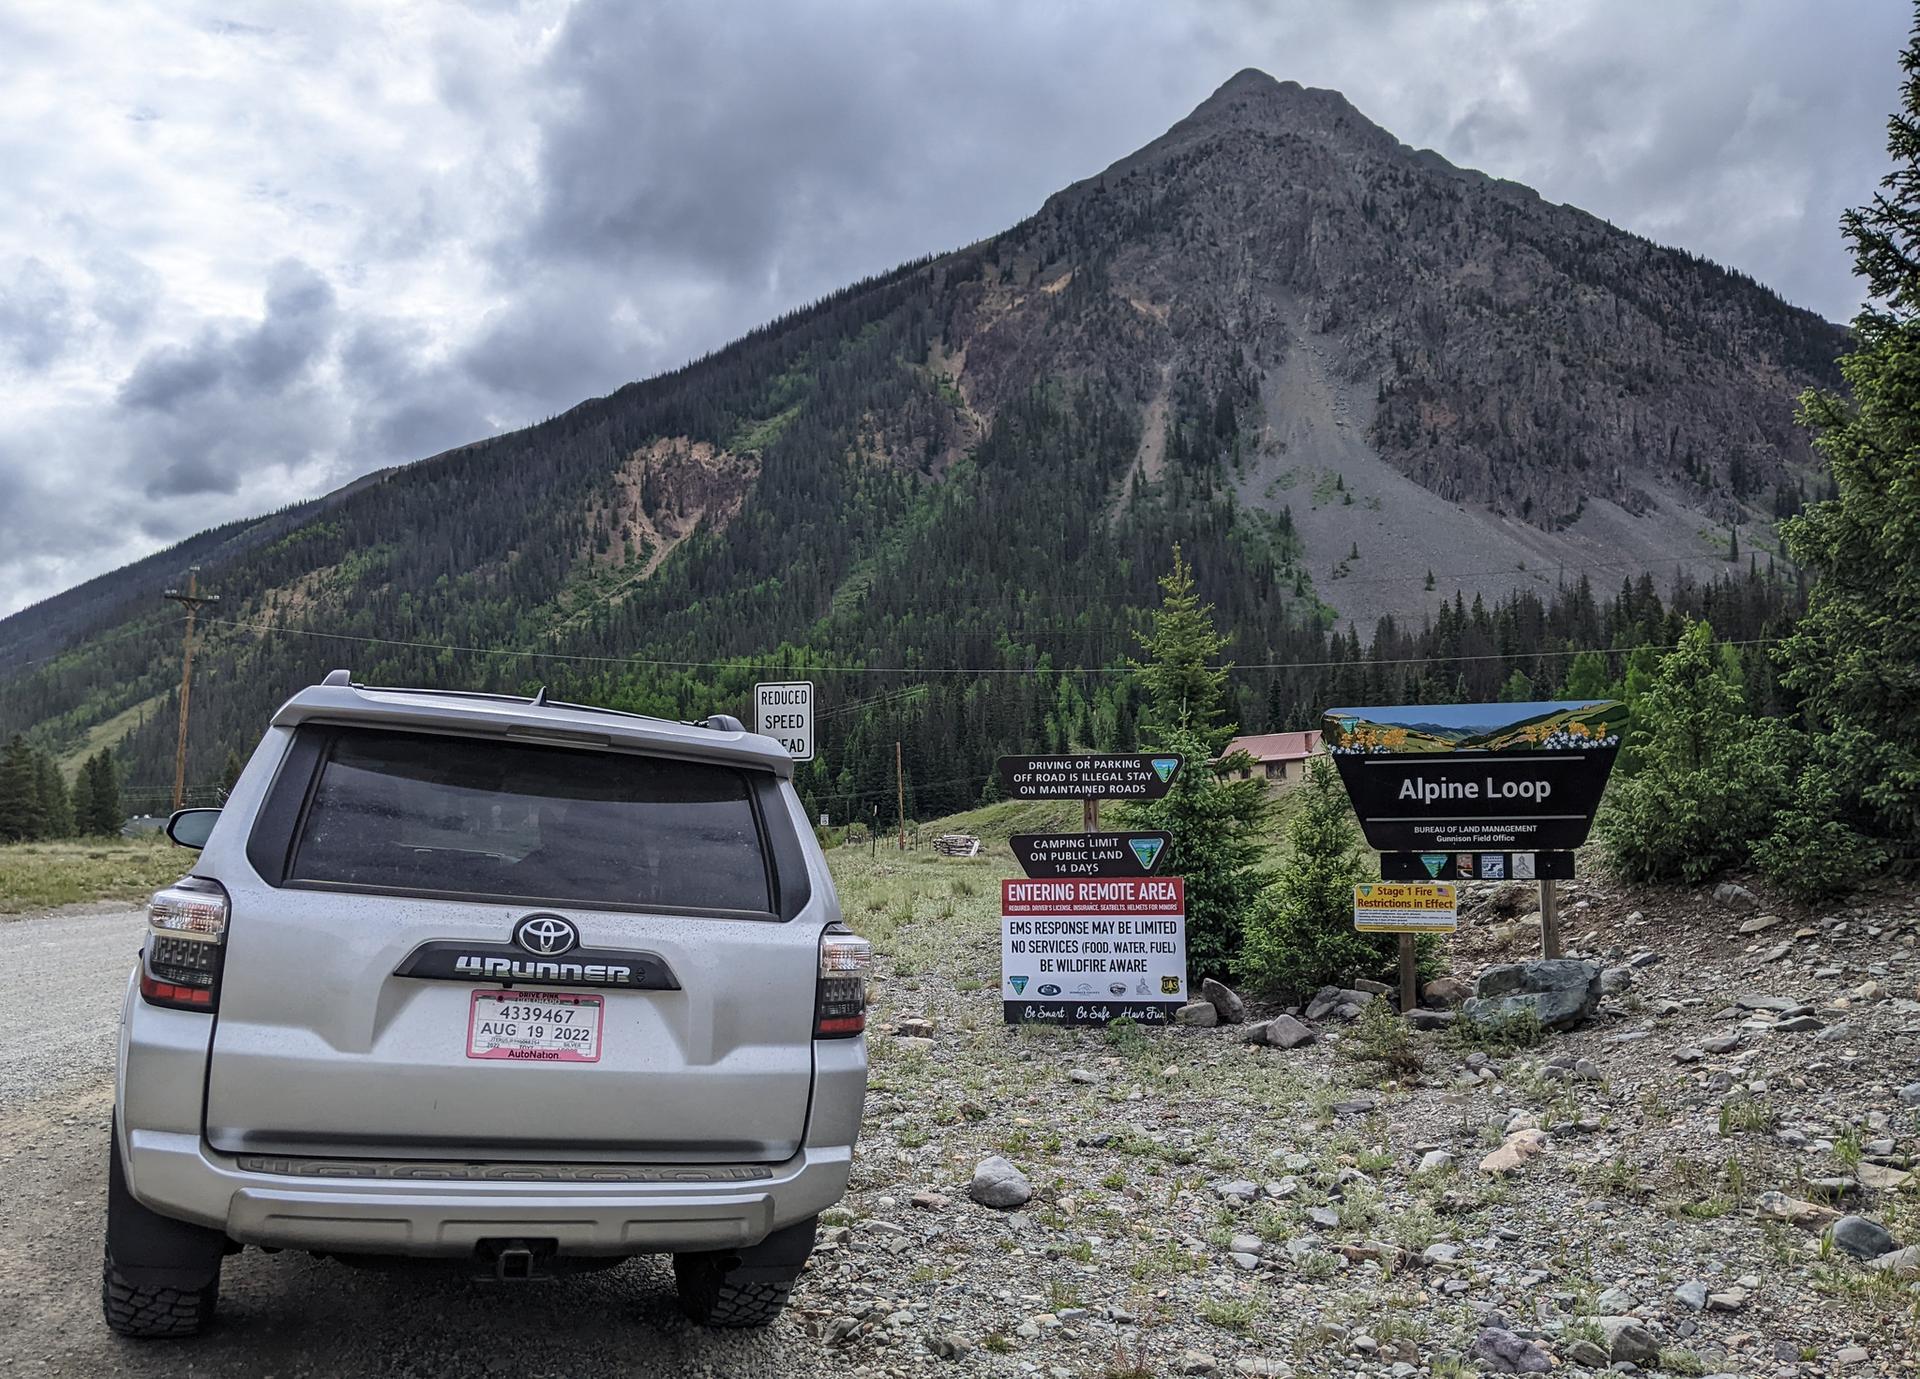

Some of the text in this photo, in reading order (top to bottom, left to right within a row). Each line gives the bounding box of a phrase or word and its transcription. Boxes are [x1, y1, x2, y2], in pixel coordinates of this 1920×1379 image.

[761, 690, 807, 705] REDUCED
[765, 714, 804, 729] SPEED
[778, 738, 805, 753] EAD
[1028, 759, 1141, 770] DRIVING OR PARKING
[1013, 771, 1153, 783] OFF ROAD IS ILLEGAL STAY
[1020, 784, 1146, 795] ON MAINTAINED ROADS
[1399, 776, 1551, 804] Alpine Loop
[1414, 824, 1538, 834] BUREAU OF LAND MANAGEMENT
[1033, 838, 1119, 849] CAMPING LIMIT
[1473, 834, 1491, 842] Field
[1492, 833, 1515, 842] Office
[1030, 850, 1123, 861] ON PUBLIC LAND
[1055, 863, 1099, 873] 14 DAYS
[1008, 882, 1177, 901] ENTERING REMOTE AREA
[1377, 886, 1432, 897] Stage 1 Fire
[1148, 903, 1158, 911] FOR
[1358, 898, 1454, 909] Restrictions in Effect
[1009, 921, 1177, 935] EMS RESPONSE MAY BE LIMITED
[1011, 940, 1176, 955] NO SERVICES (FOOD, WATER, FUEL)
[454, 955, 631, 983] 4RUNNER
[1040, 959, 1148, 972] BE WILDFIRE AWARE
[519, 991, 540, 999] DRIVE
[500, 1006, 575, 1024] 4339467
[1024, 1005, 1036, 1018] Be
[1076, 1005, 1088, 1019] Be
[1121, 1006, 1145, 1019] Have
[480, 1022, 517, 1036] AUG
[527, 1025, 544, 1038] 19
[554, 1027, 590, 1041] 2022
[508, 1049, 559, 1060] AutoNation
